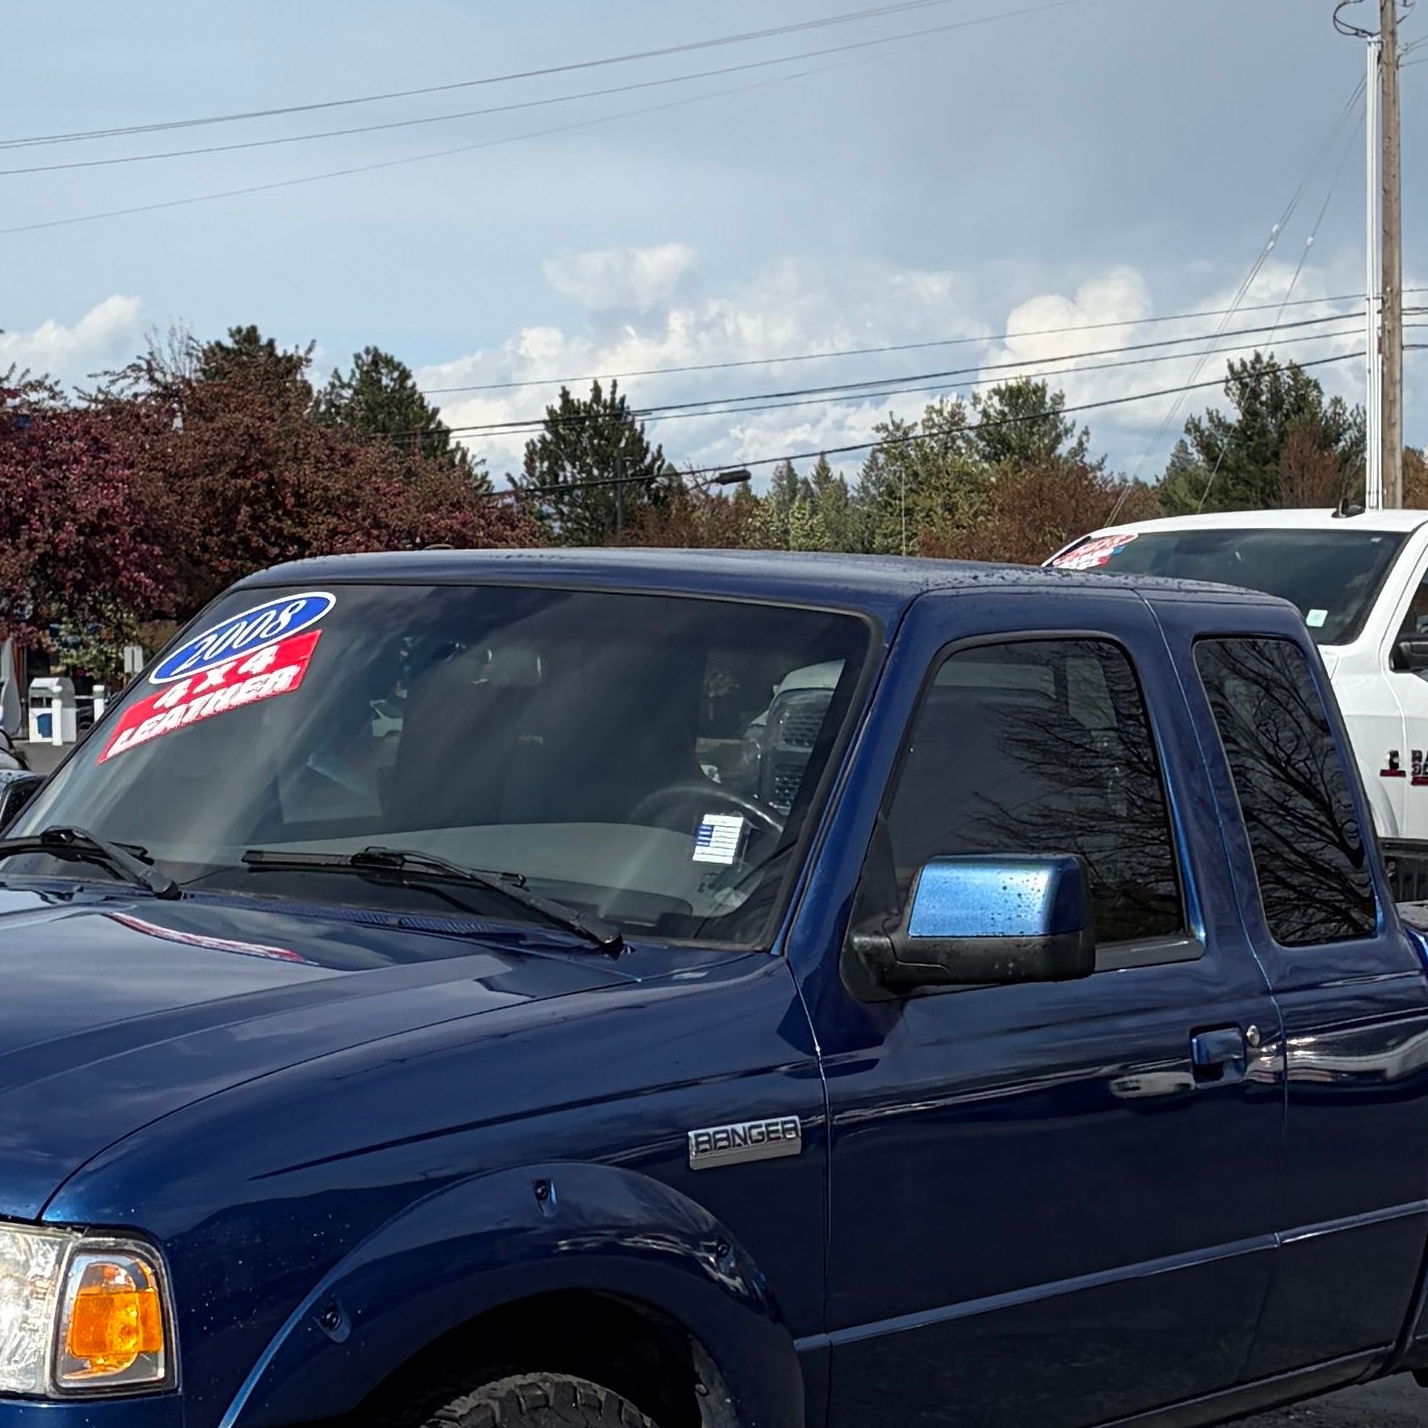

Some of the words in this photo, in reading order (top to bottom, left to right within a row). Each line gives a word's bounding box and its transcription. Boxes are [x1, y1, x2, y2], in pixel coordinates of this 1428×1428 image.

[170, 599, 306, 676] 2008
[106, 664, 301, 759] LEATHER
[153, 679, 193, 709] 4
[238, 645, 280, 674] 4
[693, 1119, 800, 1155] RANGER
